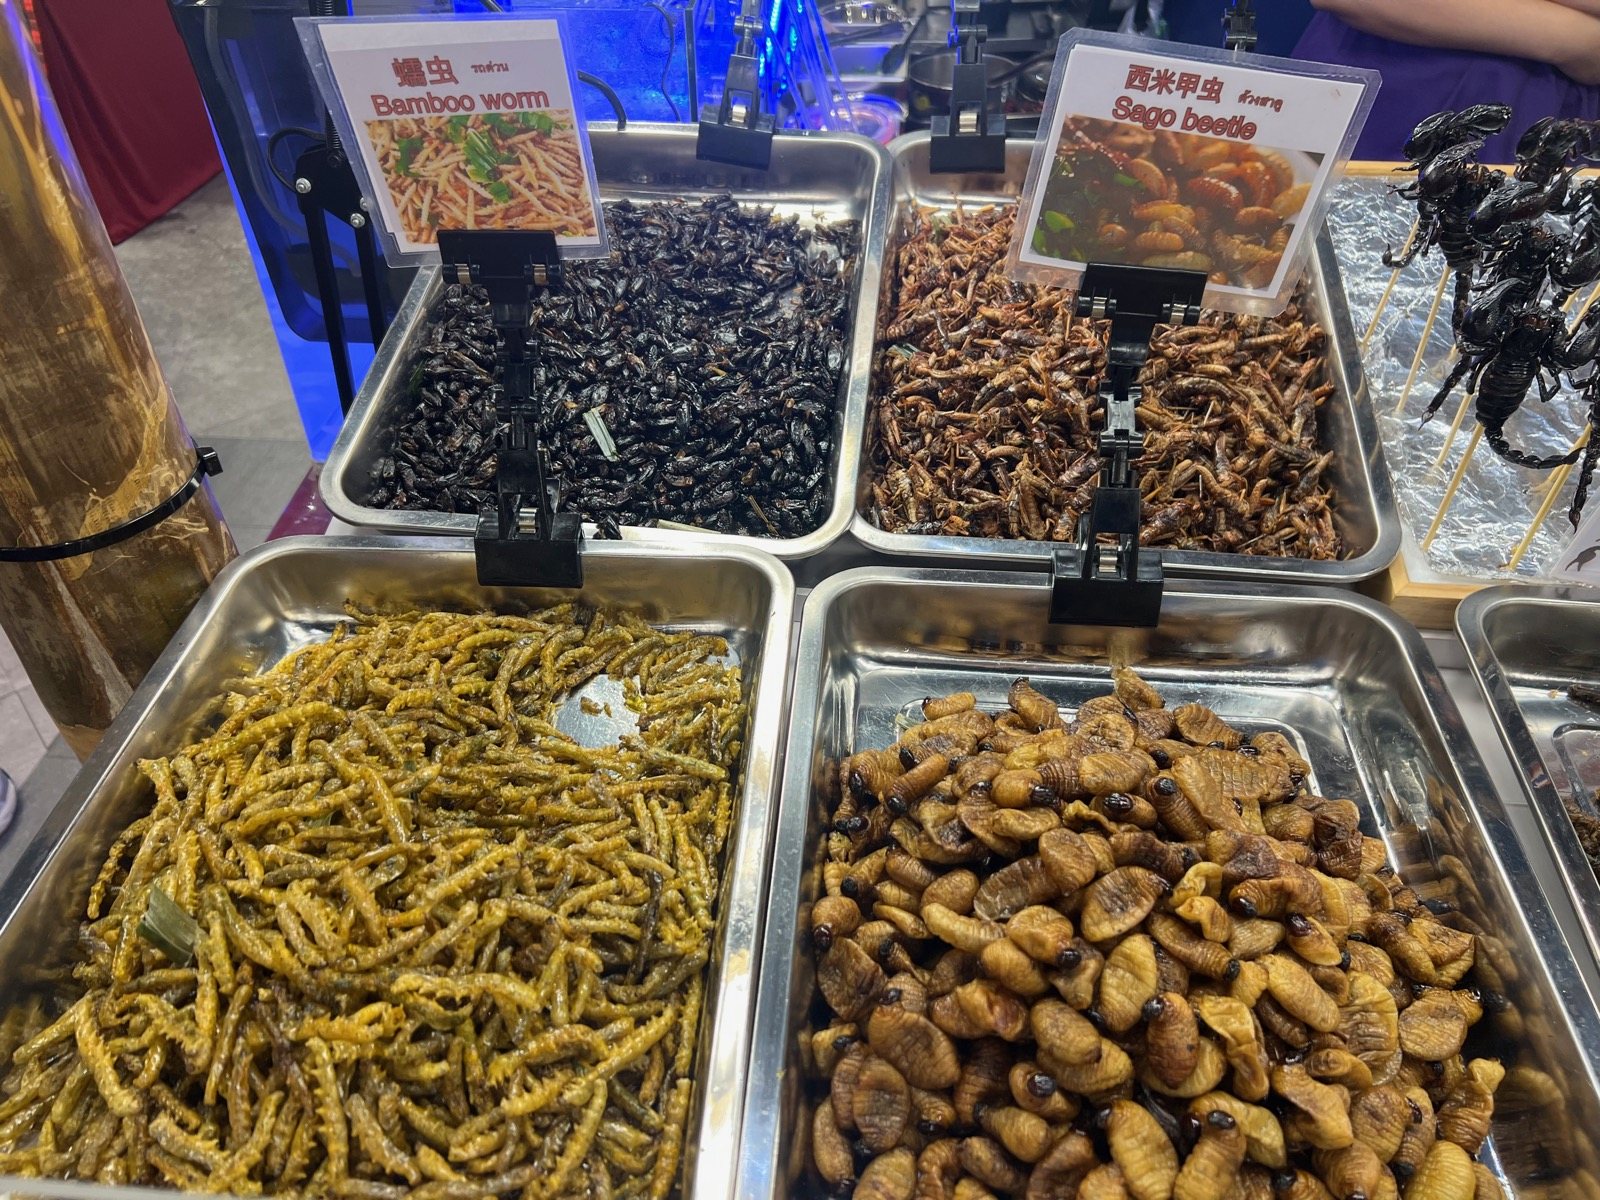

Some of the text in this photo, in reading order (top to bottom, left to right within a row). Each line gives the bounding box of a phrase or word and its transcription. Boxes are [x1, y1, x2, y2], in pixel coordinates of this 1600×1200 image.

[391, 55, 459, 87] 蠕虫
[1124, 64, 1224, 104] 西米甲虫
[370, 90, 550, 116] Bamboo worm
[1112, 96, 1257, 140] Sago beetle
